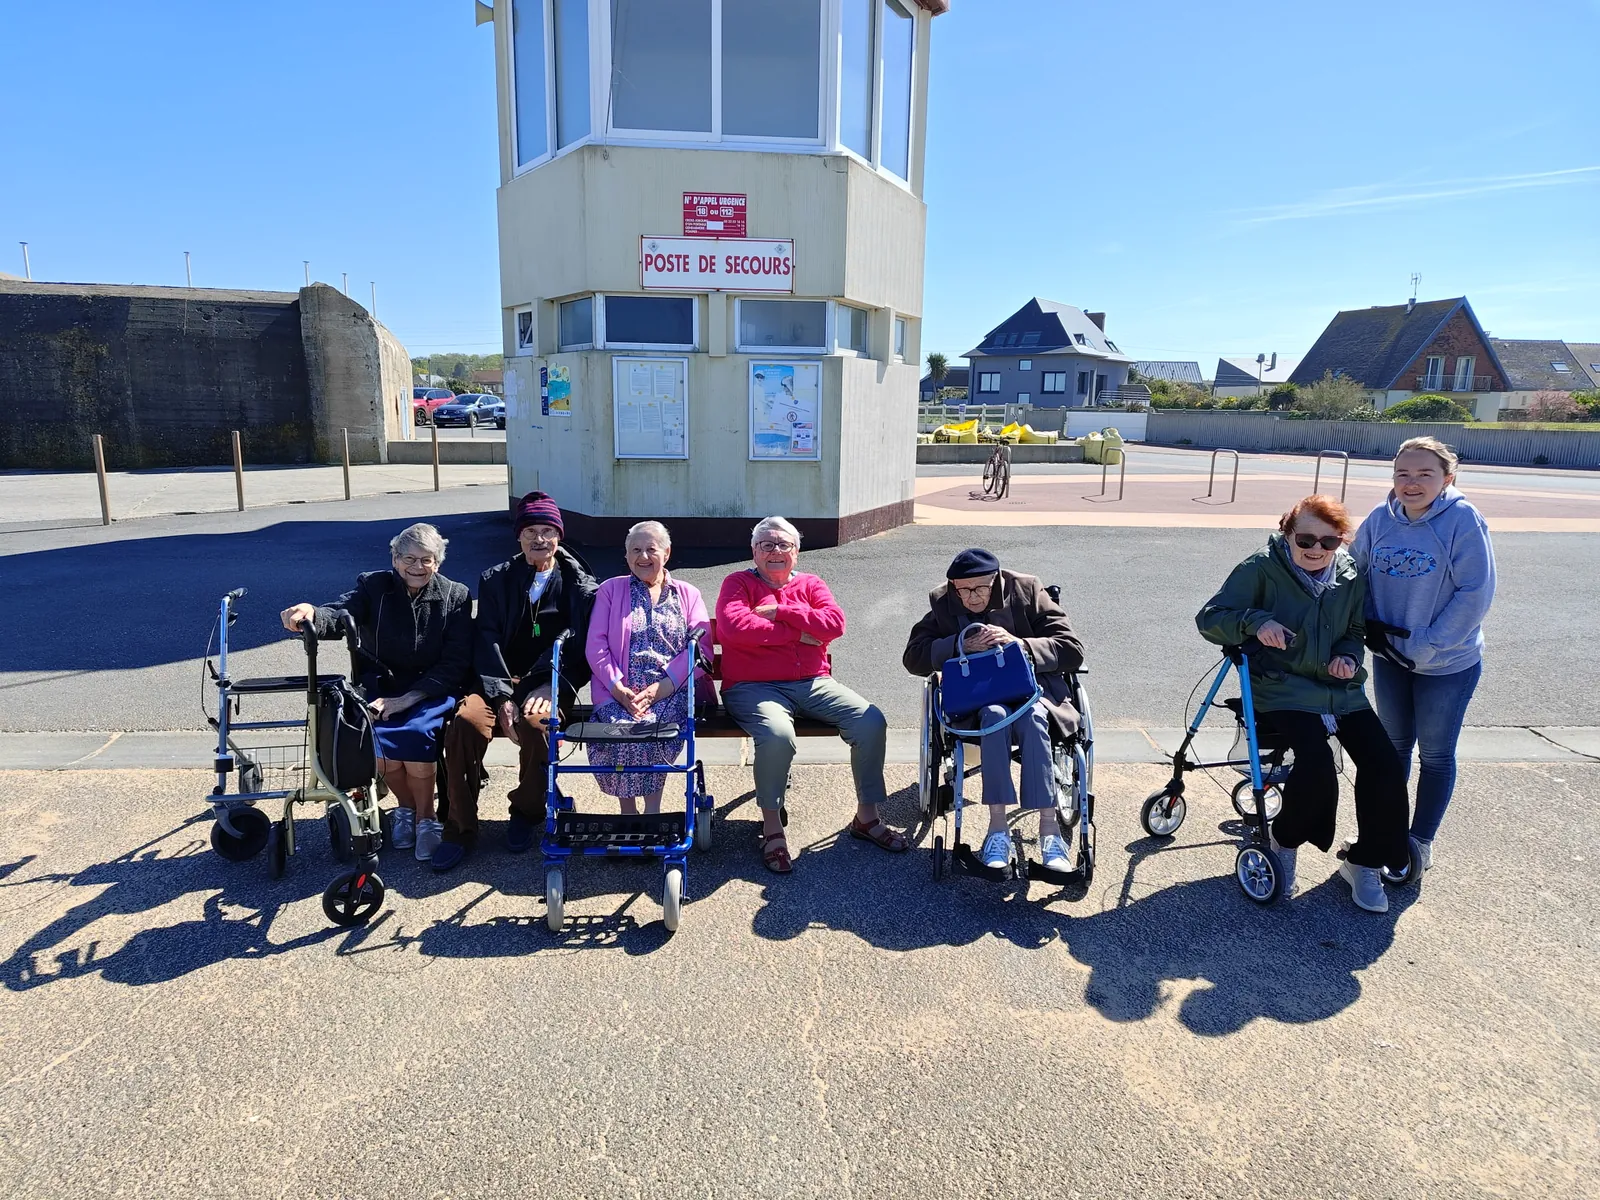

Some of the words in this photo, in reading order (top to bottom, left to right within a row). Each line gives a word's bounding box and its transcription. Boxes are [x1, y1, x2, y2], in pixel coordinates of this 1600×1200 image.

[693, 196, 718, 205] D'APPEL
[719, 197, 745, 206] URGENCE
[697, 207, 706, 215] 18
[721, 208, 732, 216] 112
[644, 253, 690, 273] POSTE
[698, 254, 716, 273] DE
[725, 255, 791, 276] SECOURS
